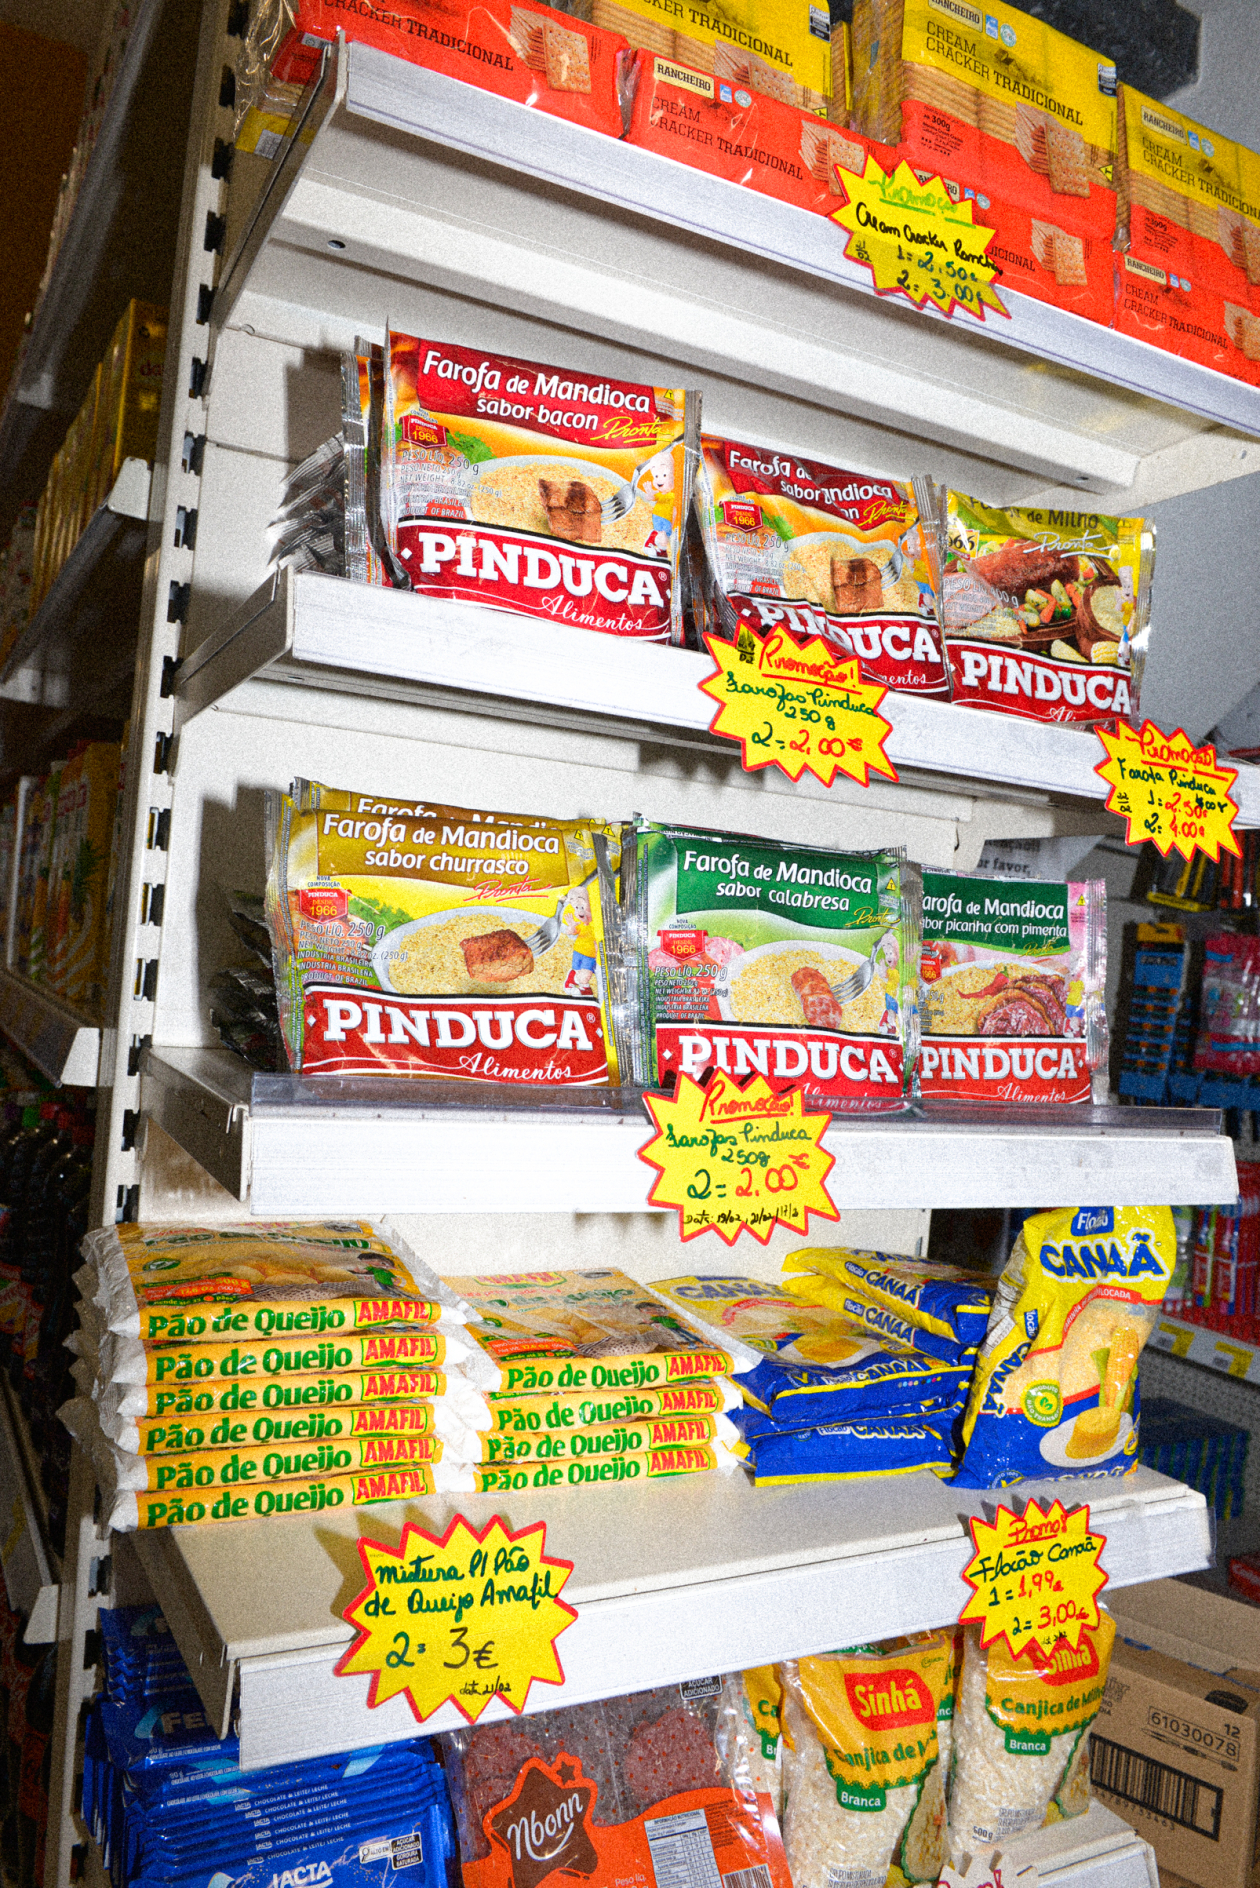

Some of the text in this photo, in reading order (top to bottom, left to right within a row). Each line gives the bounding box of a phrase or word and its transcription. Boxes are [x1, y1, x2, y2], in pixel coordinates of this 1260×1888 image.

[406, 18, 514, 71] TRADICIONAL
[682, 8, 793, 67] TRADICIONAL
[927, 20, 976, 57] CREAM
[657, 64, 711, 92] RANCHEIRO
[926, 37, 990, 81] CRACKER
[993, 70, 1083, 126] TRADICIONAL
[652, 96, 701, 123] CREAM
[1143, 112, 1184, 138] RANCHEIRO
[717, 137, 803, 180] TRADICIONAL
[1142, 136, 1182, 167] CREAM
[1143, 150, 1196, 187] CRACKER
[1127, 258, 1164, 279] RANCHEIRO
[1126, 284, 1159, 305] CREAM
[1124, 299, 1227, 349] CRACKER TRADICIONAL
[423, 351, 650, 413] Farofa de Mandioca
[477, 398, 598, 431] sabor bacon
[413, 431, 438, 443] 1966
[449, 454, 470, 469] 250
[730, 450, 791, 478] Farofa
[781, 480, 820, 501] sabor
[734, 516, 755, 526] 1966
[1027, 510, 1100, 529] de Milho
[764, 535, 781, 548] 250
[419, 532, 664, 607] PINDUCA
[541, 595, 643, 632] Alimentos
[960, 651, 1131, 715] PINDUCA
[785, 707, 821, 723] 250
[324, 813, 559, 855] Farofa de Mandioca
[365, 849, 529, 876] sabor churrasco
[684, 850, 871, 895] Farofa de Mandioca
[717, 881, 850, 911] sabor calabresa
[966, 899, 1064, 920] de Mandioca
[310, 906, 337, 916] 1966
[301, 920, 374, 937] PESO 250
[946, 918, 1066, 938] picanha com pimenta
[672, 945, 696, 954] 1966
[346, 976, 368, 986] BRAZIL
[655, 964, 718, 977] PESO 250
[323, 998, 593, 1050] PINDUCA
[460, 1052, 574, 1081] Alimentos
[679, 1035, 898, 1084] PINDUCA
[922, 1047, 1078, 1080] PINDUCA
[997, 1082, 1066, 1103] Alimentos
[738, 1121, 812, 1143] Pinduca
[1040, 1233, 1164, 1278] CANAÃ
[148, 1306, 345, 1338] Pão de Queijo
[357, 1300, 431, 1323] AMAFIL
[156, 1343, 352, 1381] Pão de Queijo
[365, 1337, 435, 1360] AMAFIL
[507, 1360, 659, 1390] Pão de Queijo
[669, 1354, 726, 1376] AMAFIL
[156, 1379, 352, 1414] Pão de Queijo
[365, 1374, 436, 1397] AMAFIL
[661, 1389, 716, 1410] AMAFIL
[355, 1408, 425, 1431] AMAFIL
[497, 1396, 653, 1432] Pão de Queijo
[147, 1413, 342, 1450] Pão de Queijo
[488, 1428, 643, 1461] Pão de Queijo
[652, 1420, 709, 1443] AMAFIL
[364, 1439, 434, 1463] AMAFIL
[650, 1449, 708, 1471] AMAFIL
[157, 1446, 352, 1488] Pão de Queijo
[482, 1457, 640, 1492] Pão de Queijo
[356, 1470, 426, 1500] AMAFIL
[147, 1483, 344, 1527] Pão de Queijo
[494, 1546, 529, 1575] Pão
[364, 1571, 558, 1623] de Queijo Amafil
[684, 1685, 720, 1697] ADICIONADO
[855, 1678, 922, 1718] Sinhá
[1001, 1697, 1063, 1721] Canjica
[1066, 1695, 1080, 1712] de
[1152, 1712, 1237, 1757] 61030078
[1224, 1723, 1240, 1739] 12
[892, 1742, 916, 1761] de
[1009, 1739, 1046, 1752] Branca
[254, 1784, 328, 1805] CHOCOLATE LECHE
[841, 1791, 881, 1807] Branca
[275, 1812, 349, 1834] CHOCOLATE LECHE
[272, 1861, 331, 1888] LACTA
[615, 1876, 634, 1887] Peso
